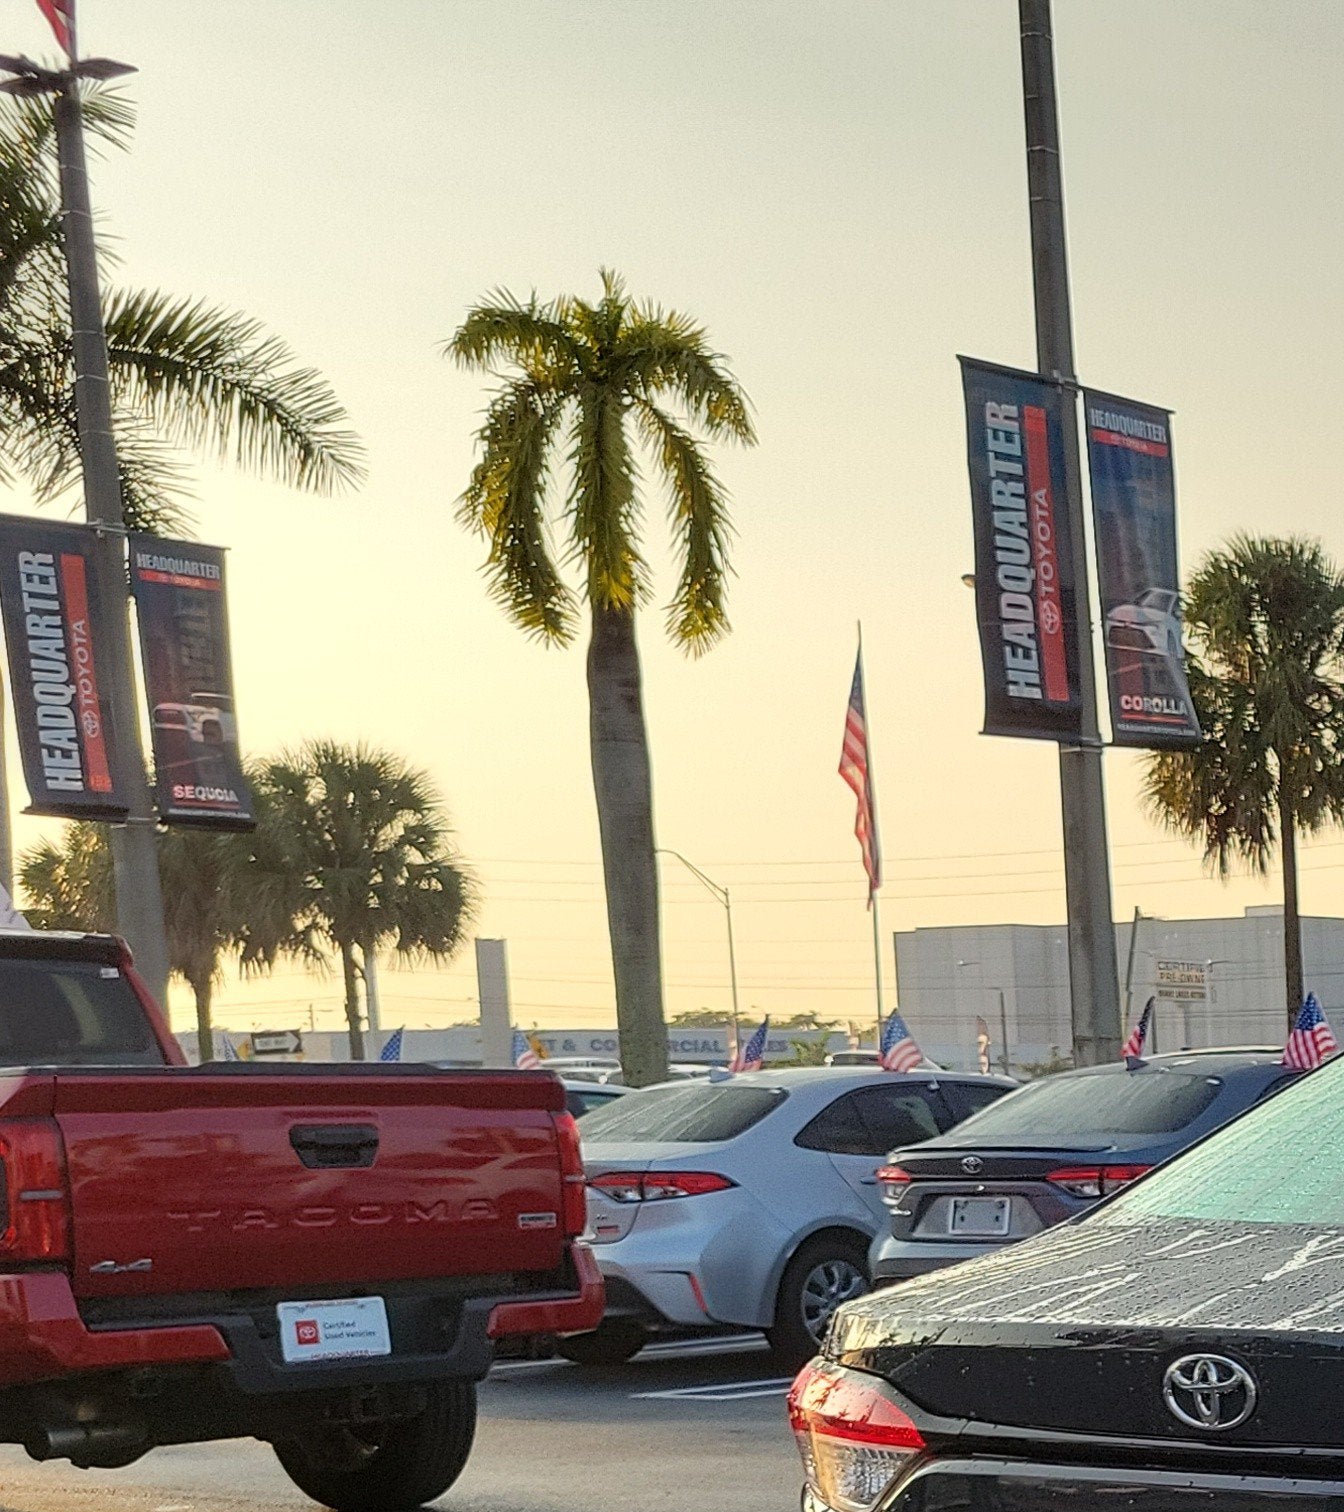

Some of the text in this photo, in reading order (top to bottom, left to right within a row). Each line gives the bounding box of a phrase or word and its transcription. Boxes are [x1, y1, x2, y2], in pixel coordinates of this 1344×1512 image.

[1090, 408, 1167, 443] HEADQUARTER
[136, 553, 220, 579] HEADQUARTER
[985, 401, 1043, 700] HEADQUARTER
[1032, 488, 1057, 599] TOYOTA
[18, 551, 84, 792] HEADQUARTER
[72, 620, 96, 707] TOYOTA
[173, 784, 239, 802] SEQUOIA
[168, 1200, 498, 1232] TACOMA
